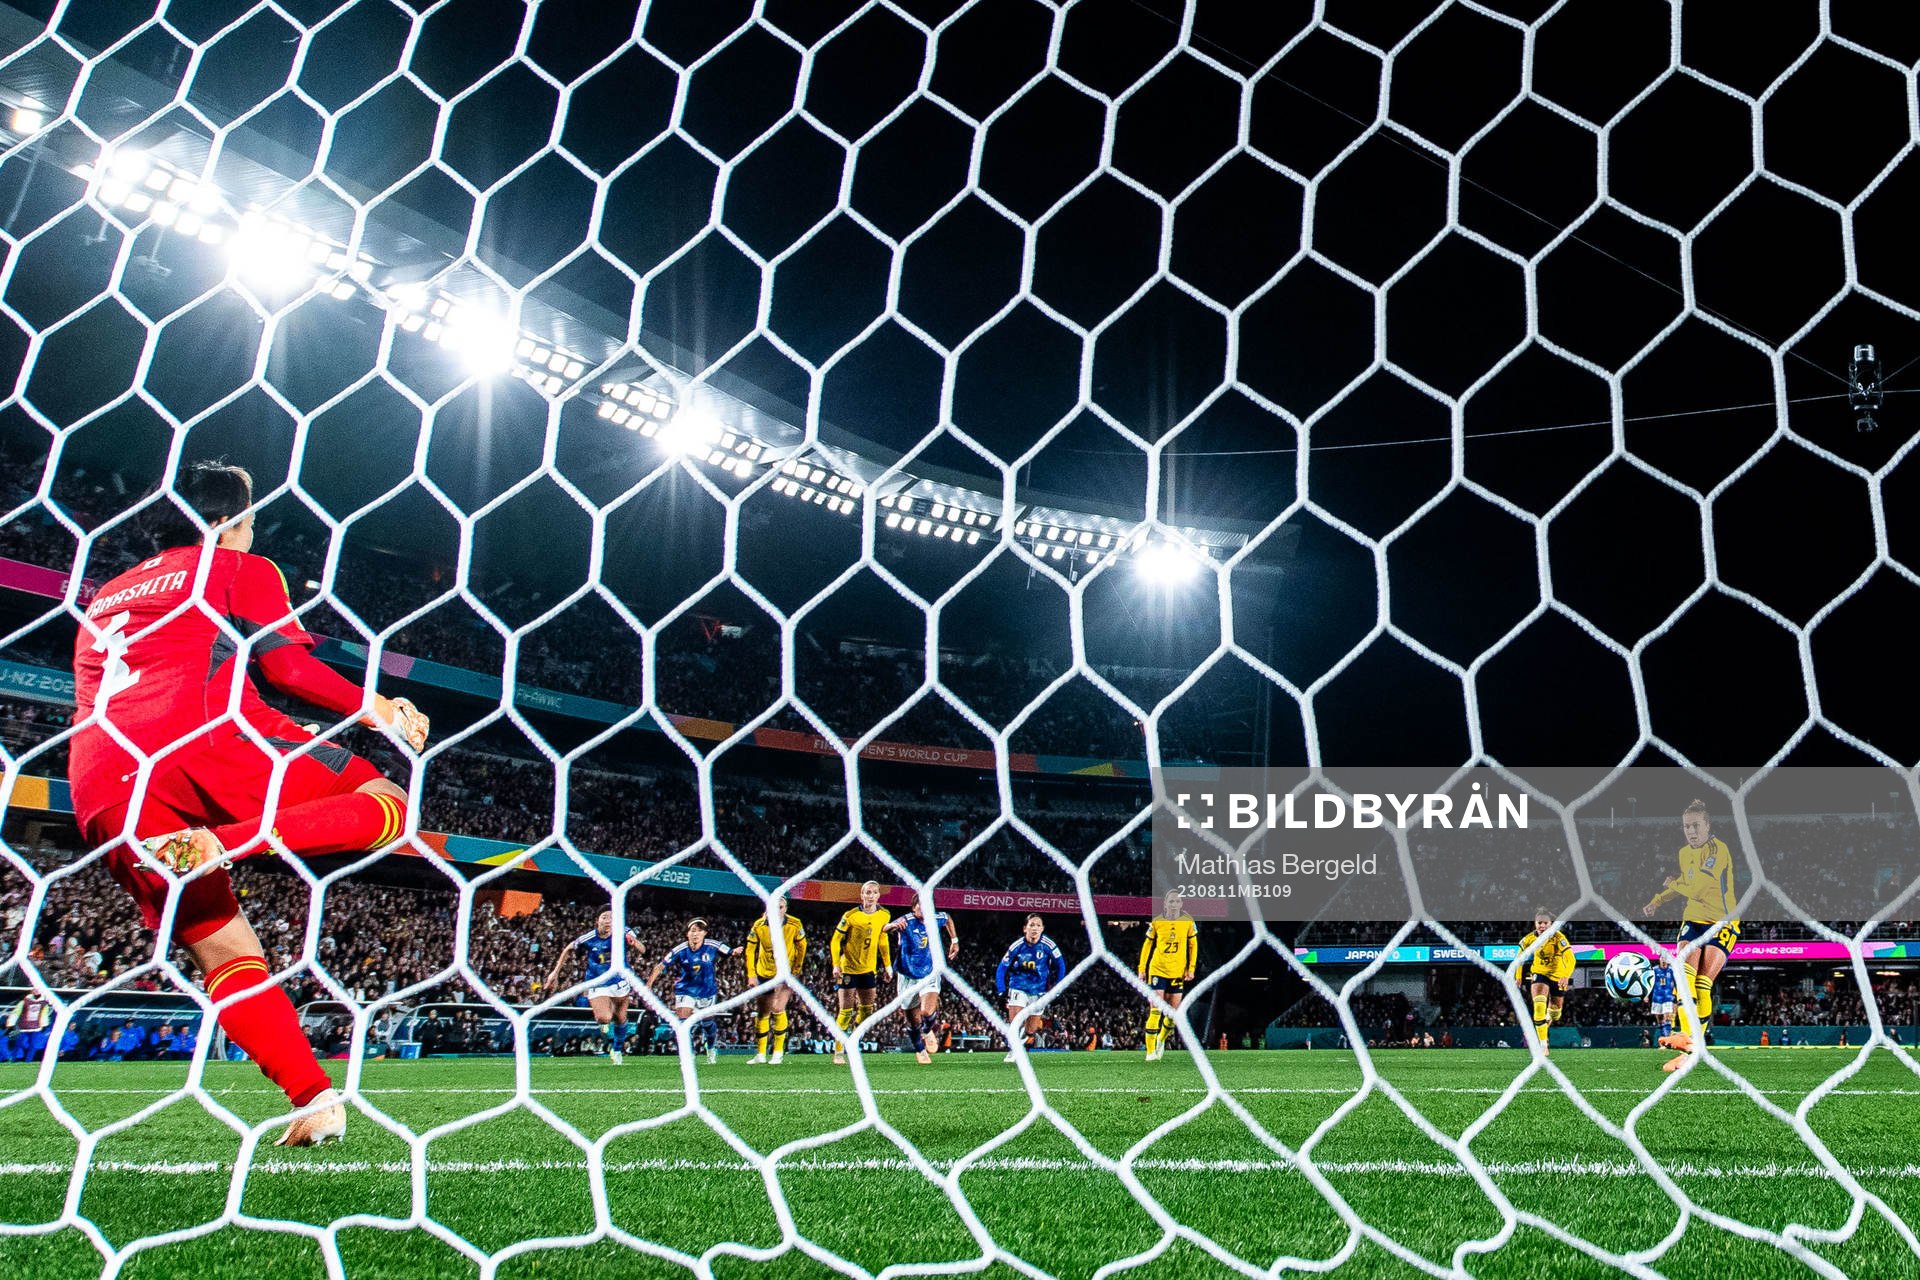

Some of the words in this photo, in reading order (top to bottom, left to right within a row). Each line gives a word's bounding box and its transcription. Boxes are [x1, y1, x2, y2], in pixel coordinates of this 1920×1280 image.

[899, 748, 940, 761] WORLD
[944, 752, 968, 763] CUP
[963, 894, 1014, 907] BEYOND
[1018, 897, 1082, 909] GREATNES
[863, 937, 871, 950] 9
[1164, 941, 1179, 954] 23
[1345, 950, 1382, 960] JAPAN
[1415, 950, 1421, 960] 1
[1433, 949, 1481, 959] SWEDN
